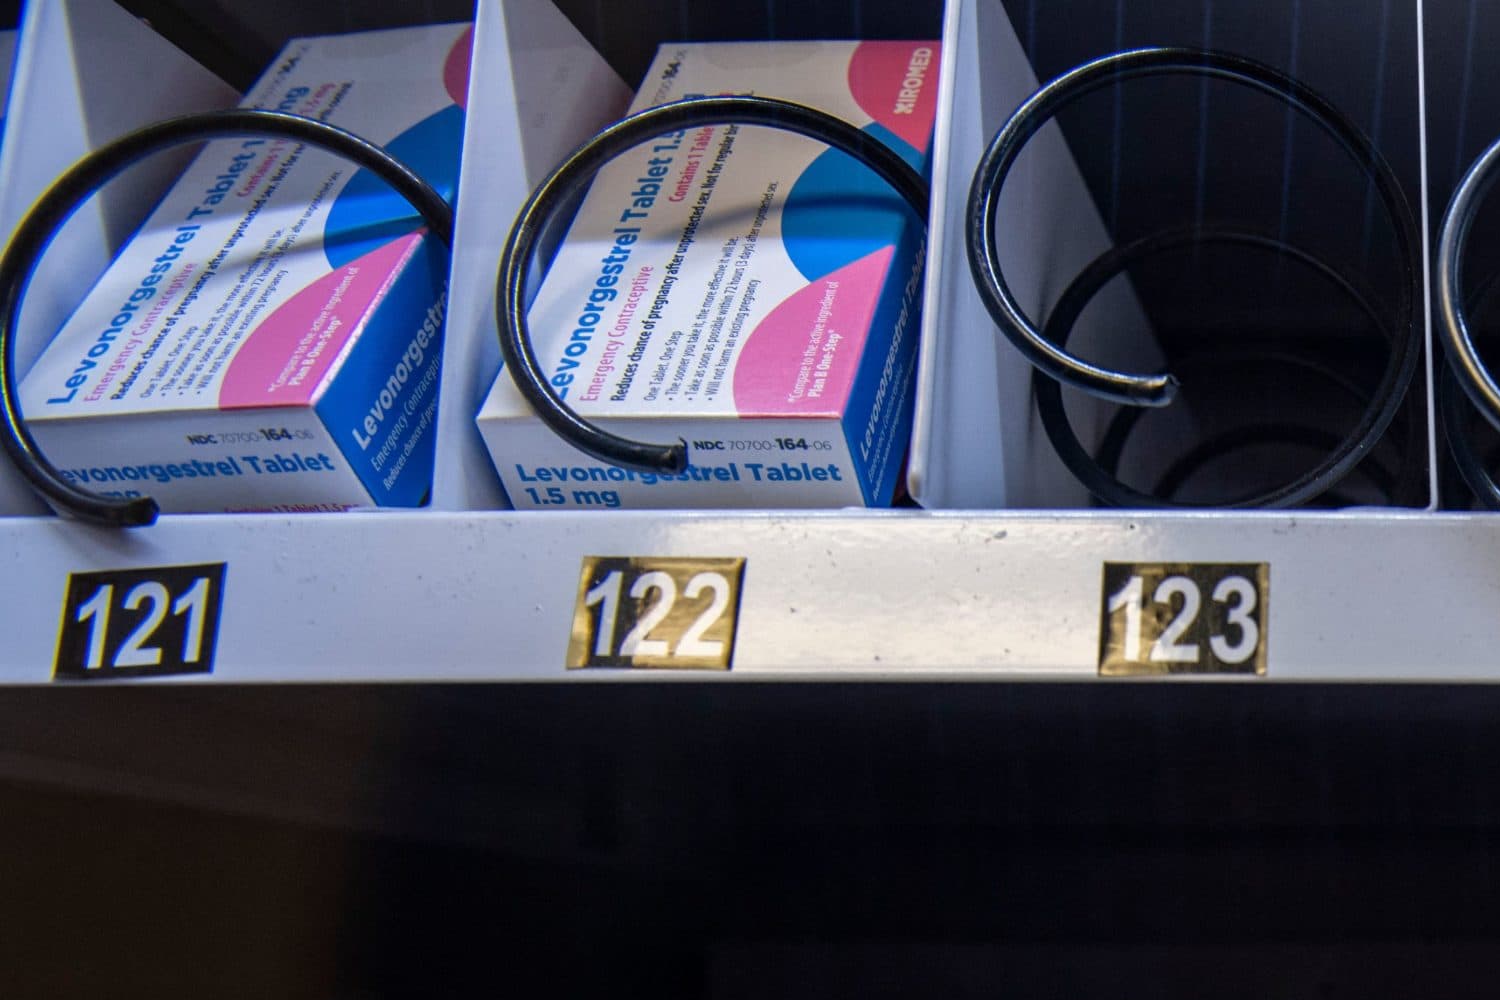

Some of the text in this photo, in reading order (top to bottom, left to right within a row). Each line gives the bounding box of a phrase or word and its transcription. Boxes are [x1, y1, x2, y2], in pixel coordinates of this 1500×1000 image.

[616, 157, 672, 221] Tablet
[45, 153, 254, 402] Levonorgestrel Tablet
[82, 262, 199, 401] Emergency Contraceptive
[578, 265, 655, 400] Emergency Contraceptive
[287, 365, 310, 385] Plan
[807, 377, 825, 396] Plan
[187, 434, 217, 446] NDC
[694, 437, 832, 451] NDC 70700-164-06
[60, 452, 336, 483] evonorgestrel Tablet
[745, 462, 842, 481] Tablet
[525, 487, 621, 507] 1.5 mg
[78, 578, 210, 670] 121
[585, 570, 730, 658] 122
[1108, 575, 1259, 663] 123
